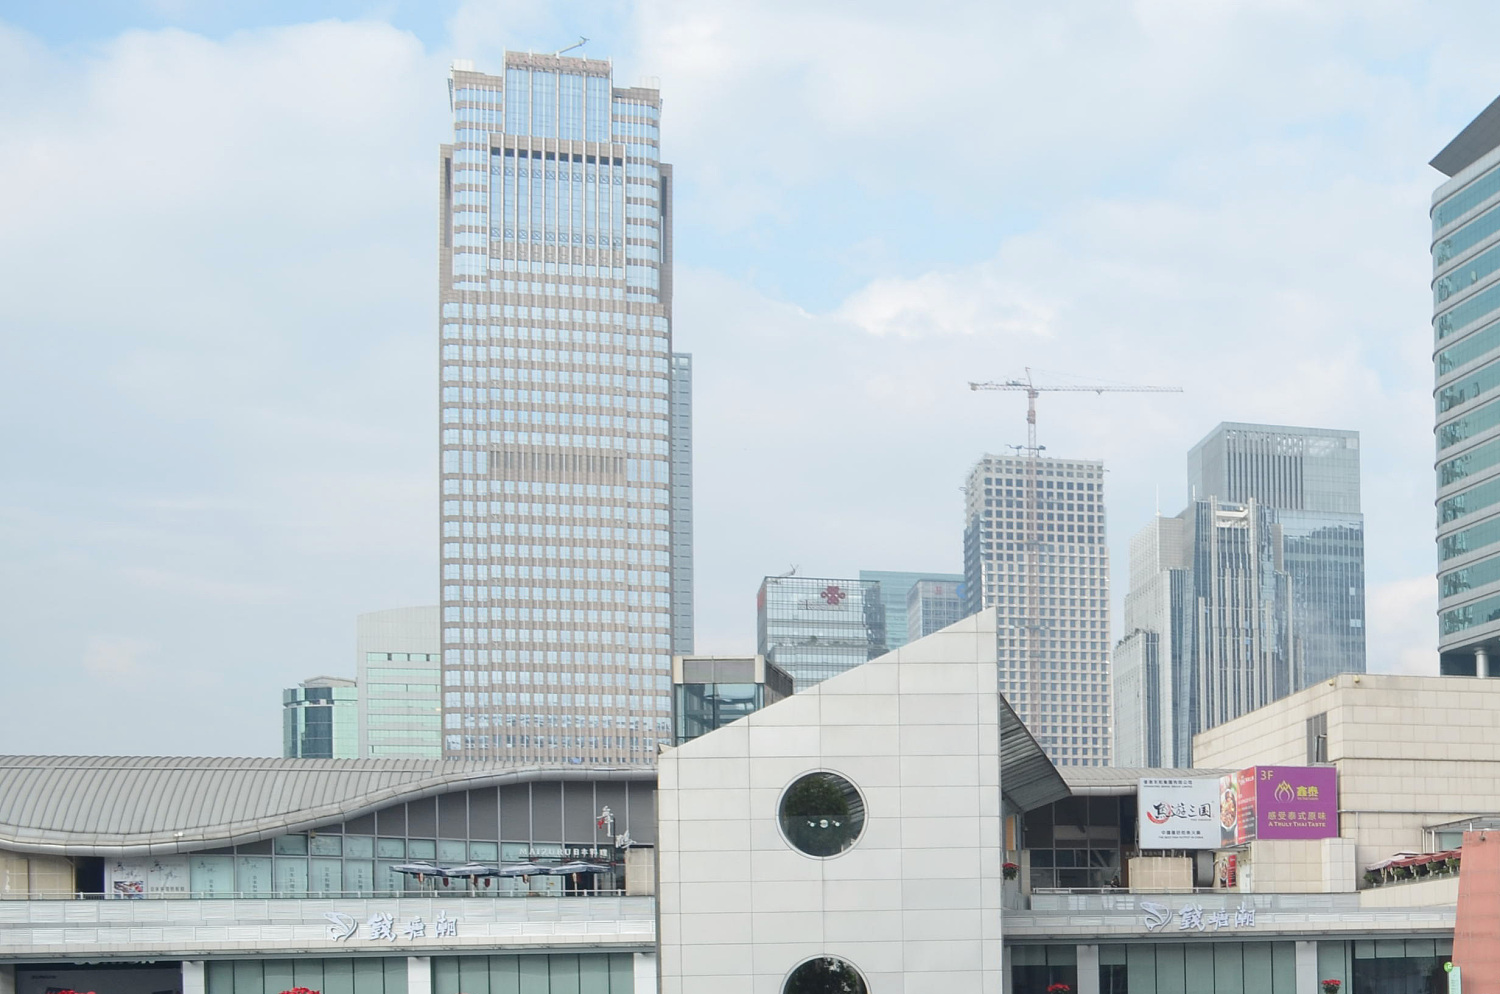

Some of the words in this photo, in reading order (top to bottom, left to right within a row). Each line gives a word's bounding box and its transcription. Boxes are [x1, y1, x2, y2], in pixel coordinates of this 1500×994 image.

[1260, 770, 1274, 780] 3F
[1267, 811, 1327, 820] 感受泰式原味
